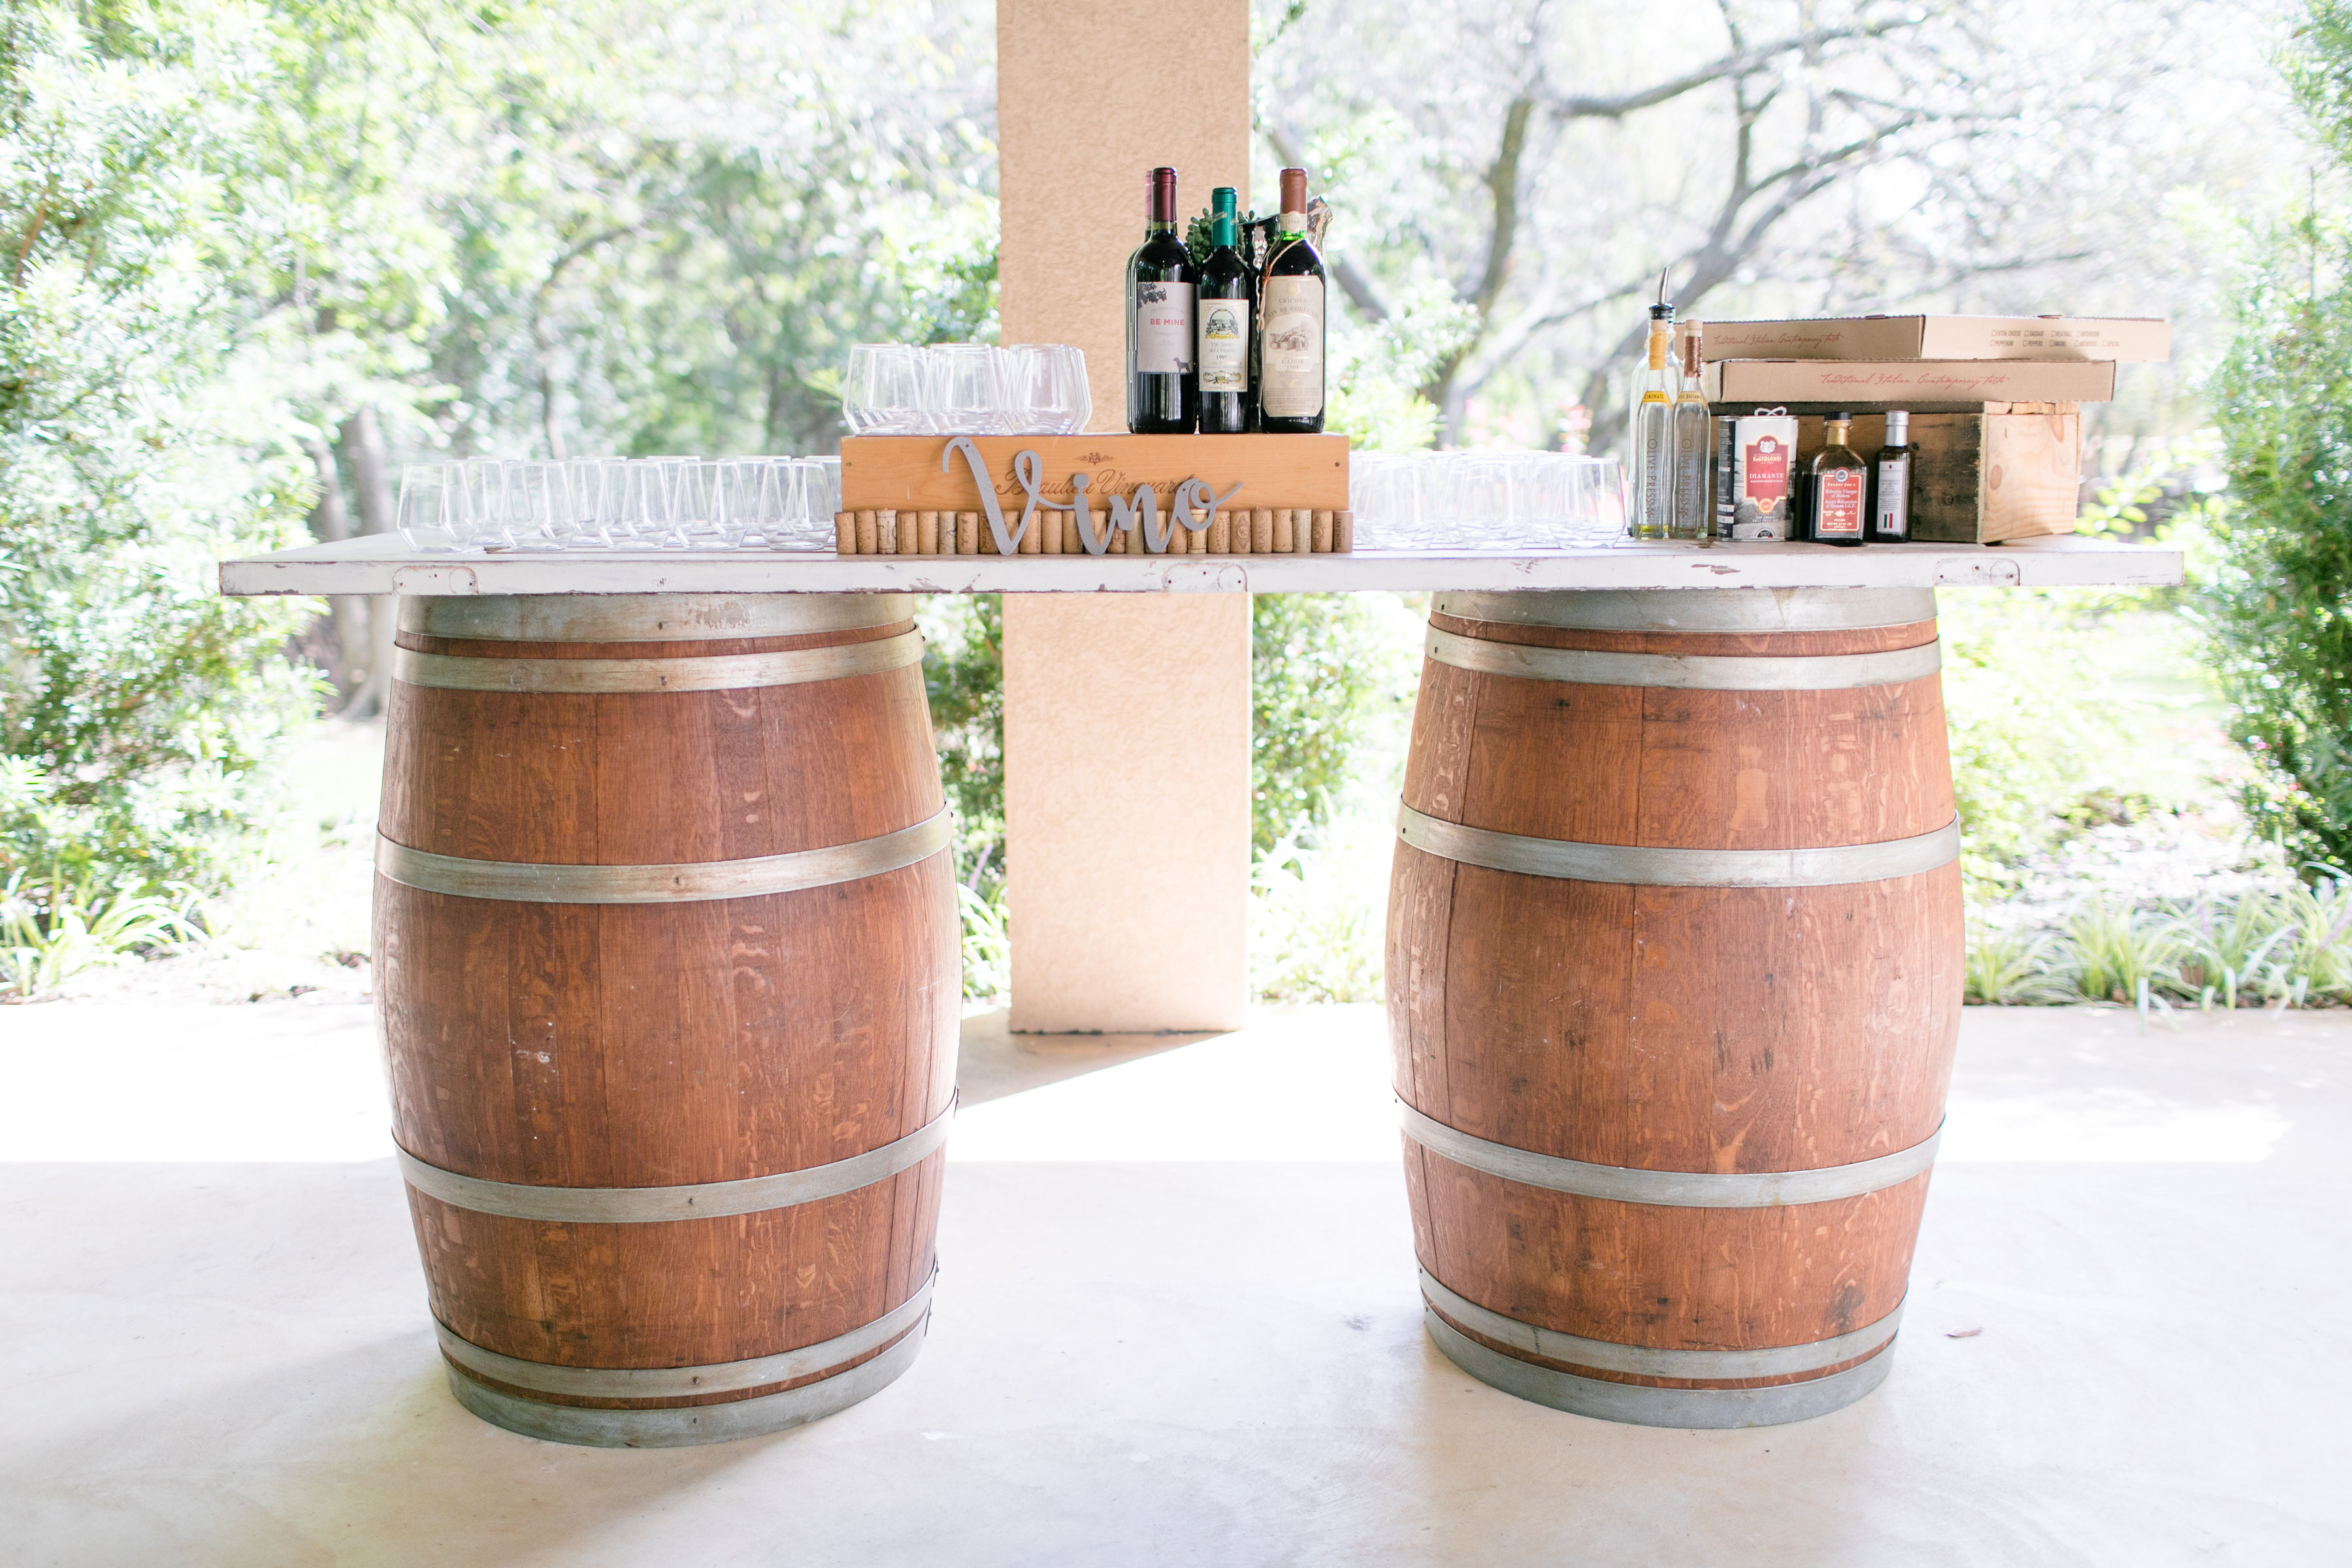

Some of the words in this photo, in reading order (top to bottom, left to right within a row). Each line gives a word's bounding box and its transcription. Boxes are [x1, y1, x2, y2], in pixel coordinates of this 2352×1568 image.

[1778, 333, 1821, 349] Contemporary
[1821, 373, 1876, 384] Traditional
[1918, 373, 1980, 391] Contemporary
[943, 436, 1243, 557] Vino
[1258, 514, 1266, 553] ALAMOS
